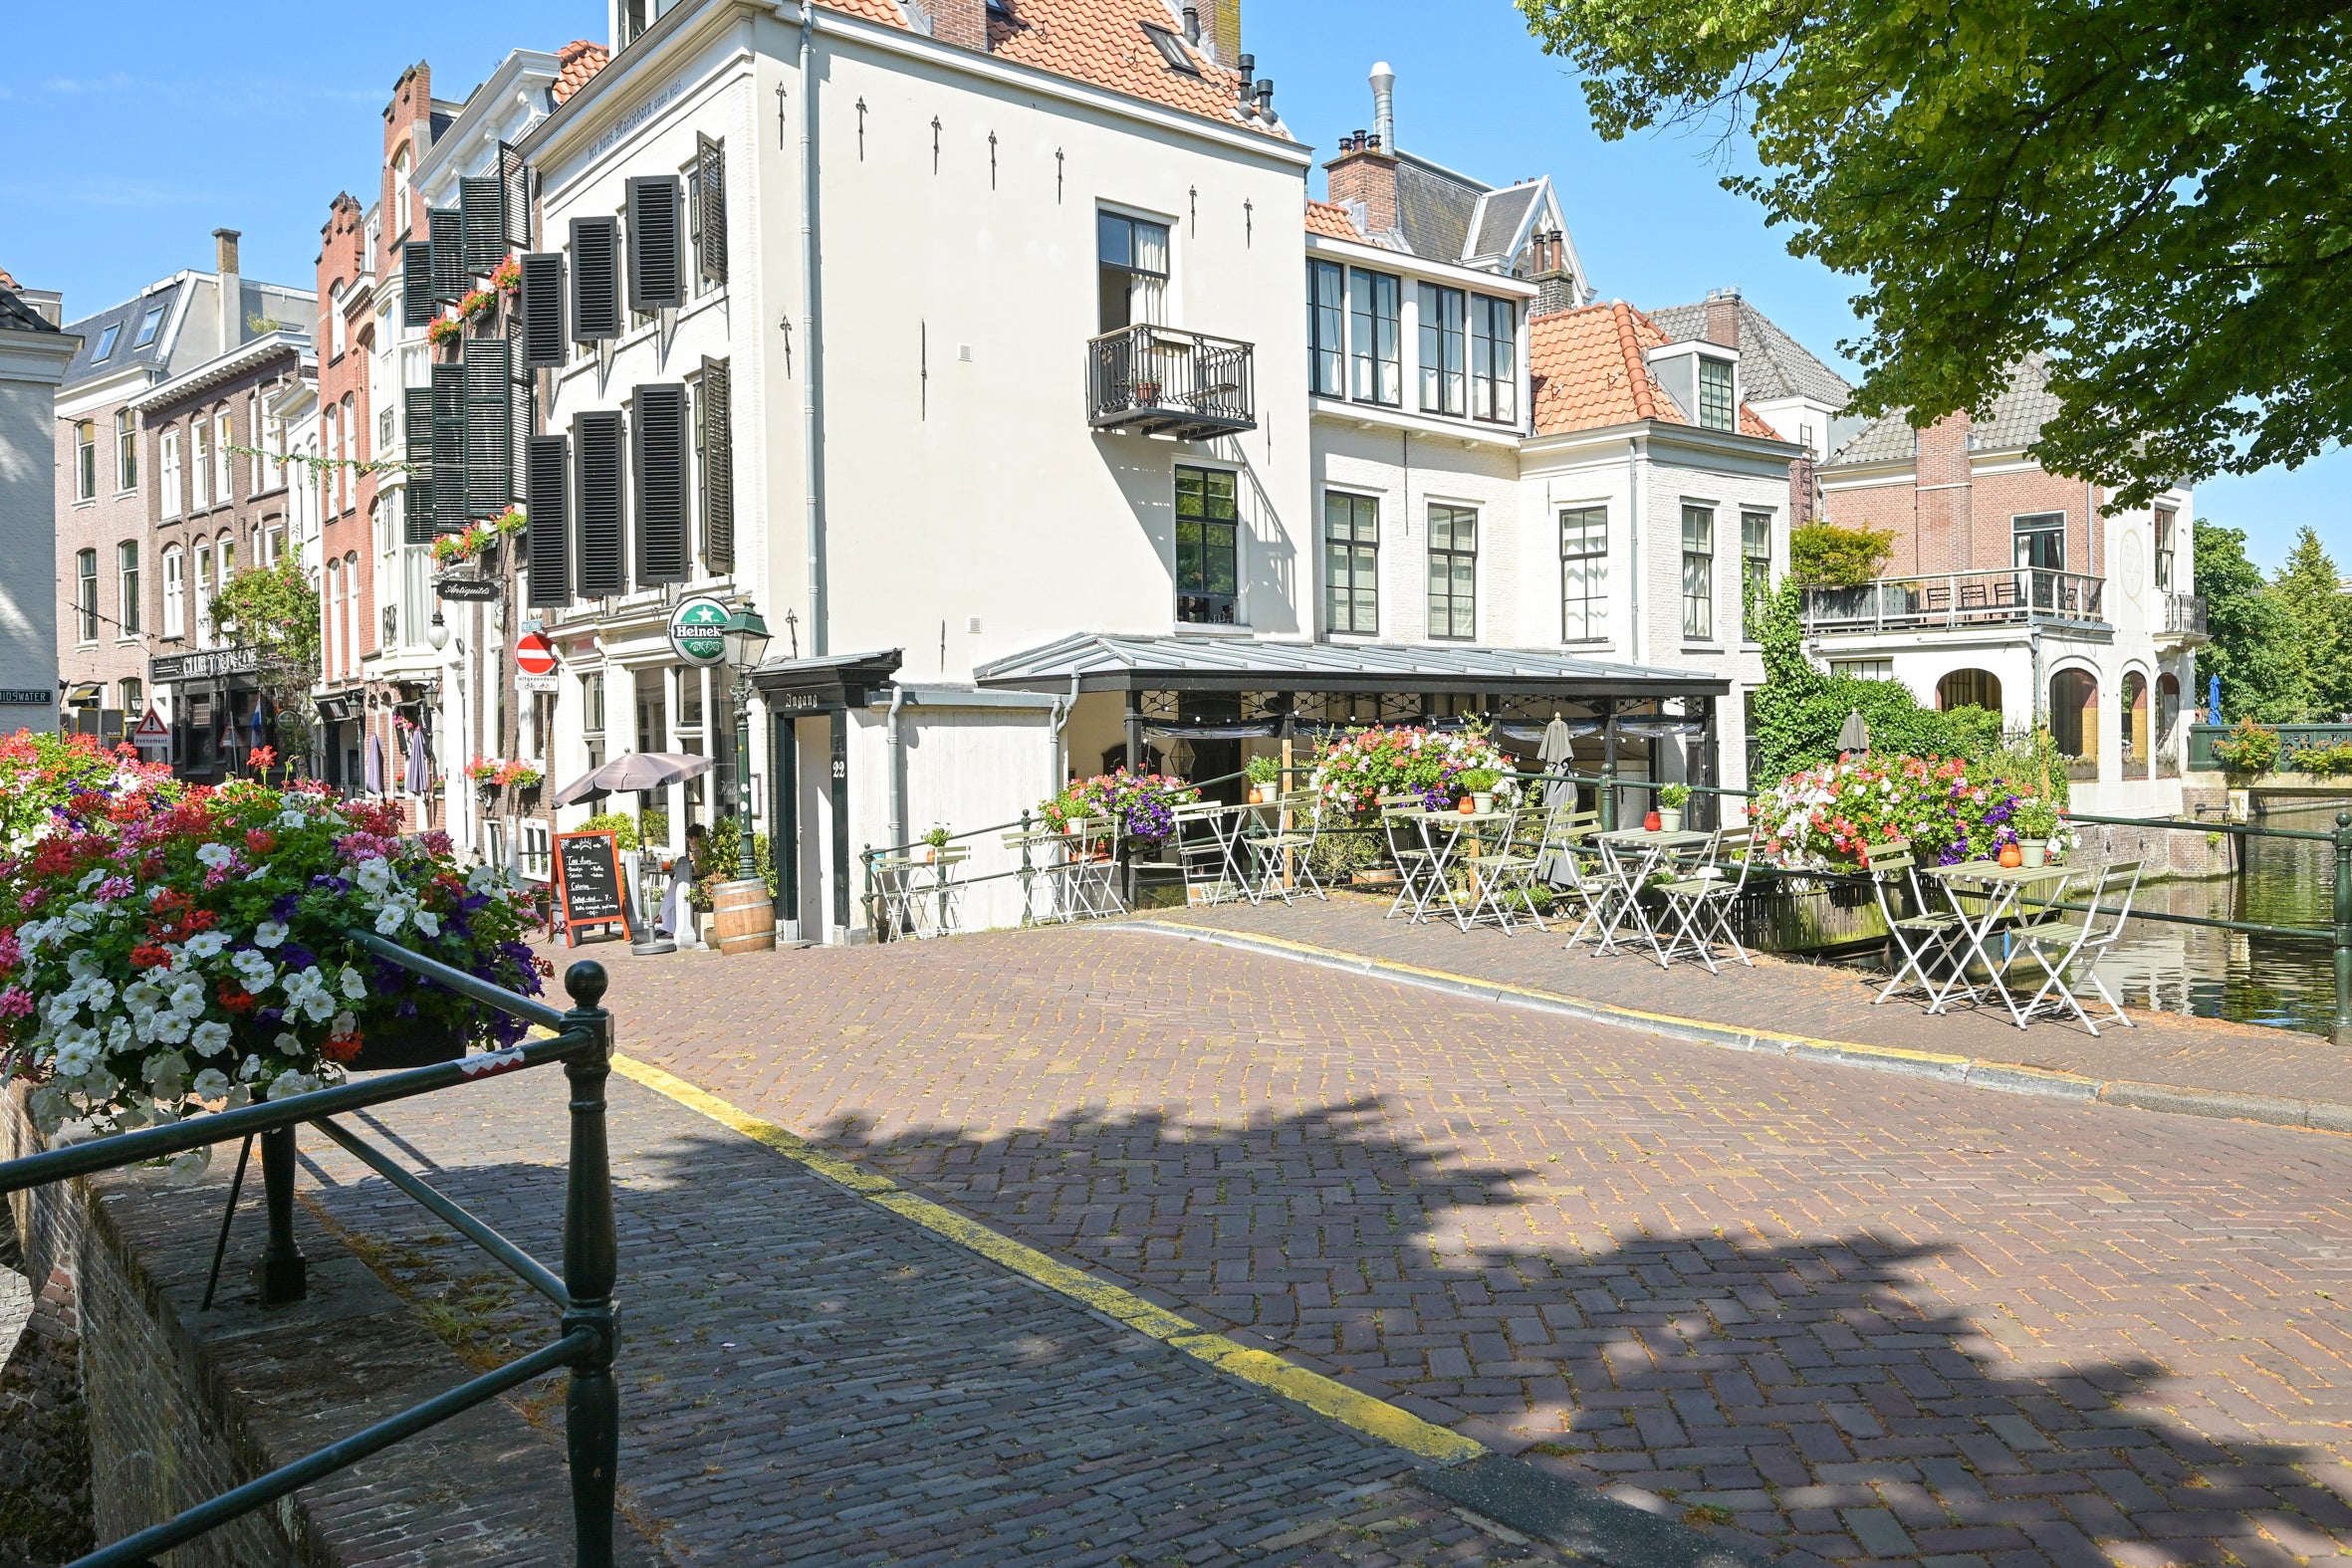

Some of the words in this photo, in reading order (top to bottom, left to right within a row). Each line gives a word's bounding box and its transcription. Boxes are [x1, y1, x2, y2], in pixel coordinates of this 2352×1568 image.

[676, 625, 723, 637] Heinek
[182, 656, 207, 677] CLUB
[0, 692, 46, 702] IDSWATER
[785, 693, 818, 709] Ingang
[832, 761, 845, 779] 22
